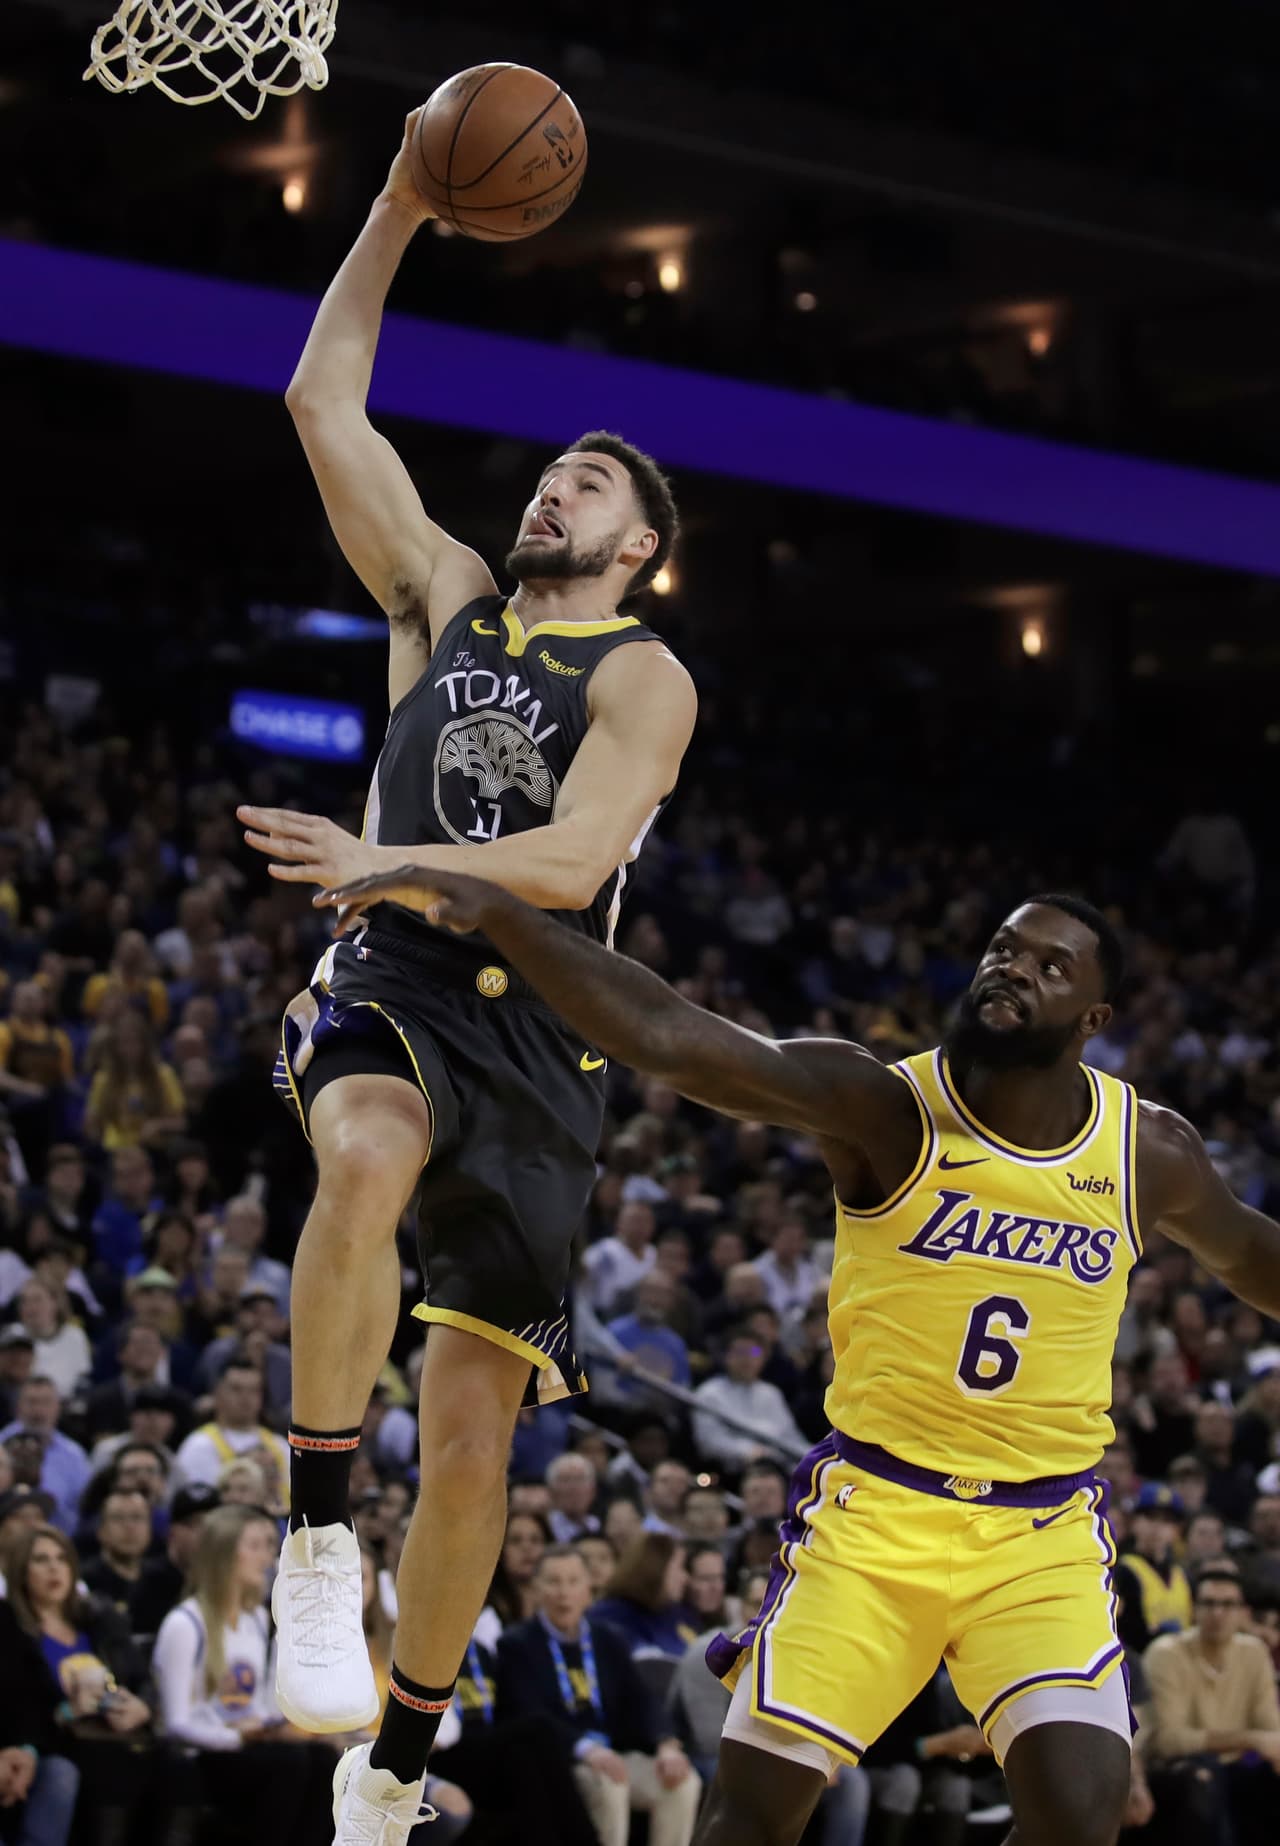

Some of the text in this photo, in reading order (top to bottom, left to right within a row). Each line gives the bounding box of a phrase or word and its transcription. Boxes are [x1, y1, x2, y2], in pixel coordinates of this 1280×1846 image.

[1066, 1172, 1115, 1196] wish
[898, 1189, 1119, 1284] LAKERS
[954, 1294, 1031, 1399] 6
